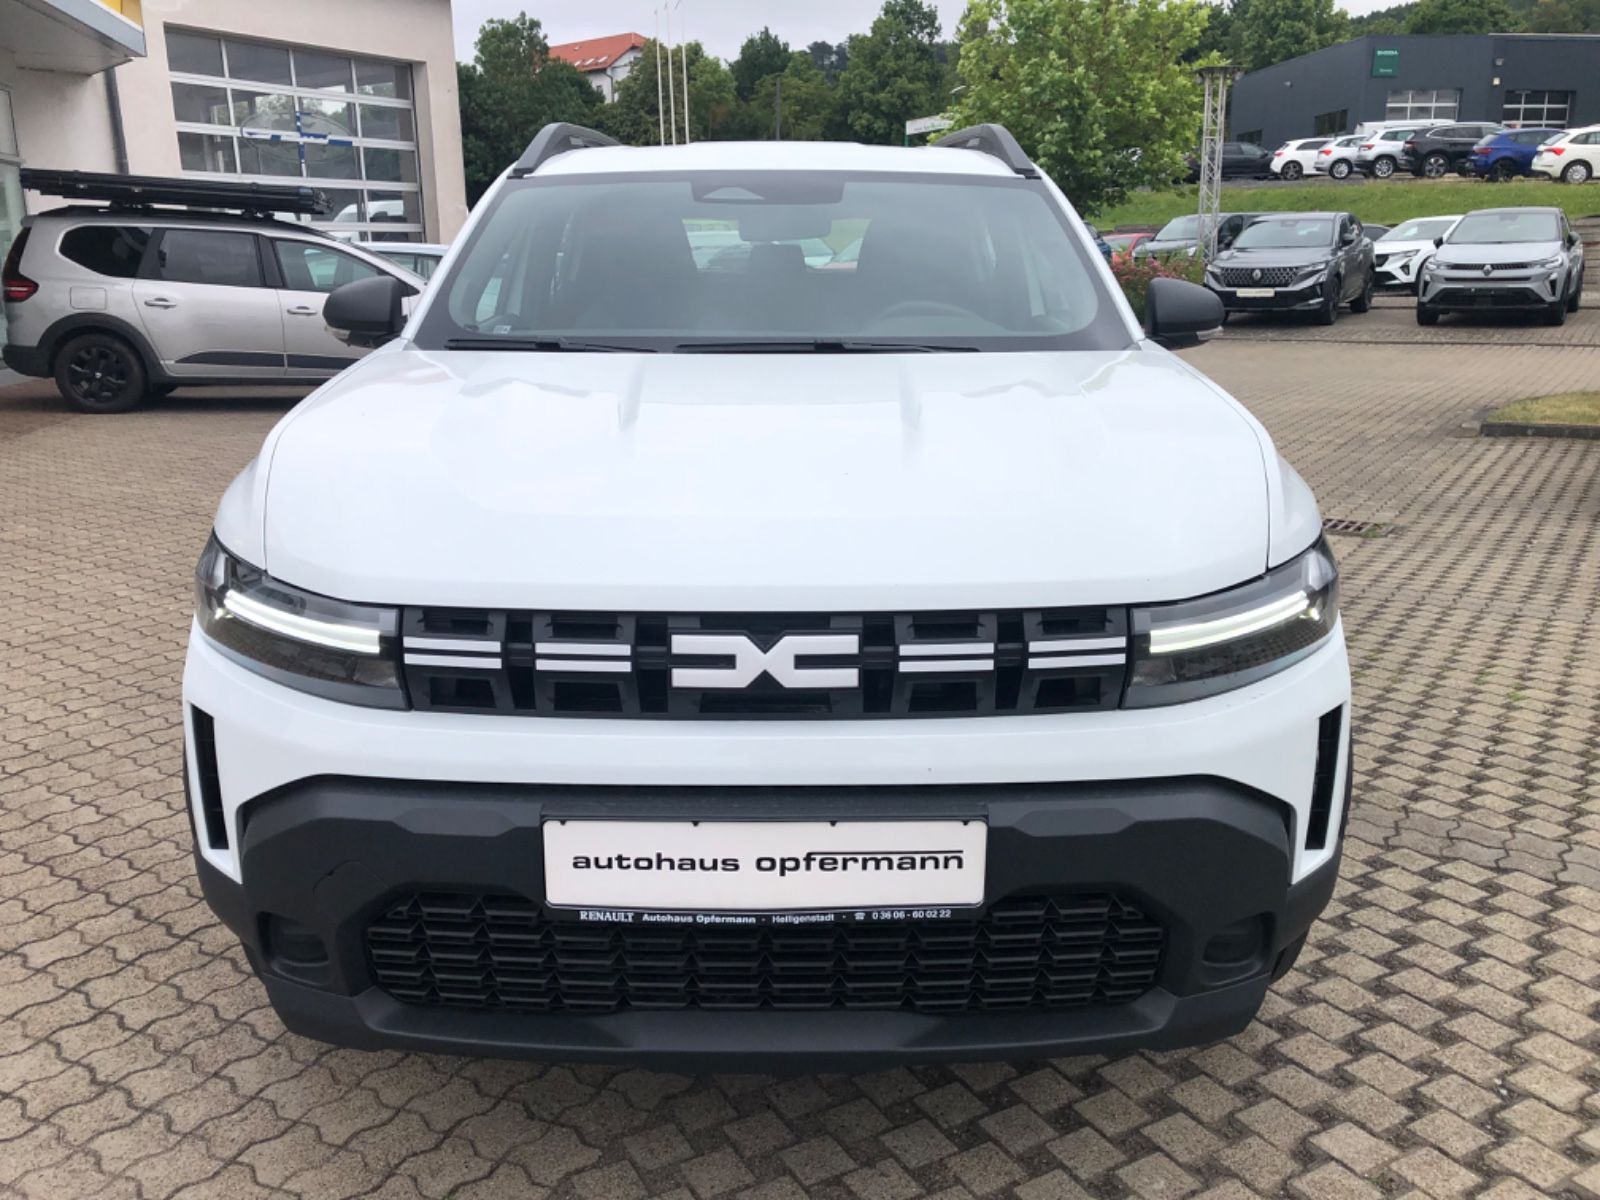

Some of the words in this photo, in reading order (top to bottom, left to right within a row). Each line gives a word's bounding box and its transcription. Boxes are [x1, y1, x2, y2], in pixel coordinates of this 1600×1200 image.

[572, 852, 740, 872] autohaus
[755, 850, 964, 877] opfermann
[579, 910, 634, 923] RENAULT
[642, 913, 693, 923] Autohaus
[696, 914, 756, 925] Opfermann
[772, 913, 835, 925] Heiligenstadt
